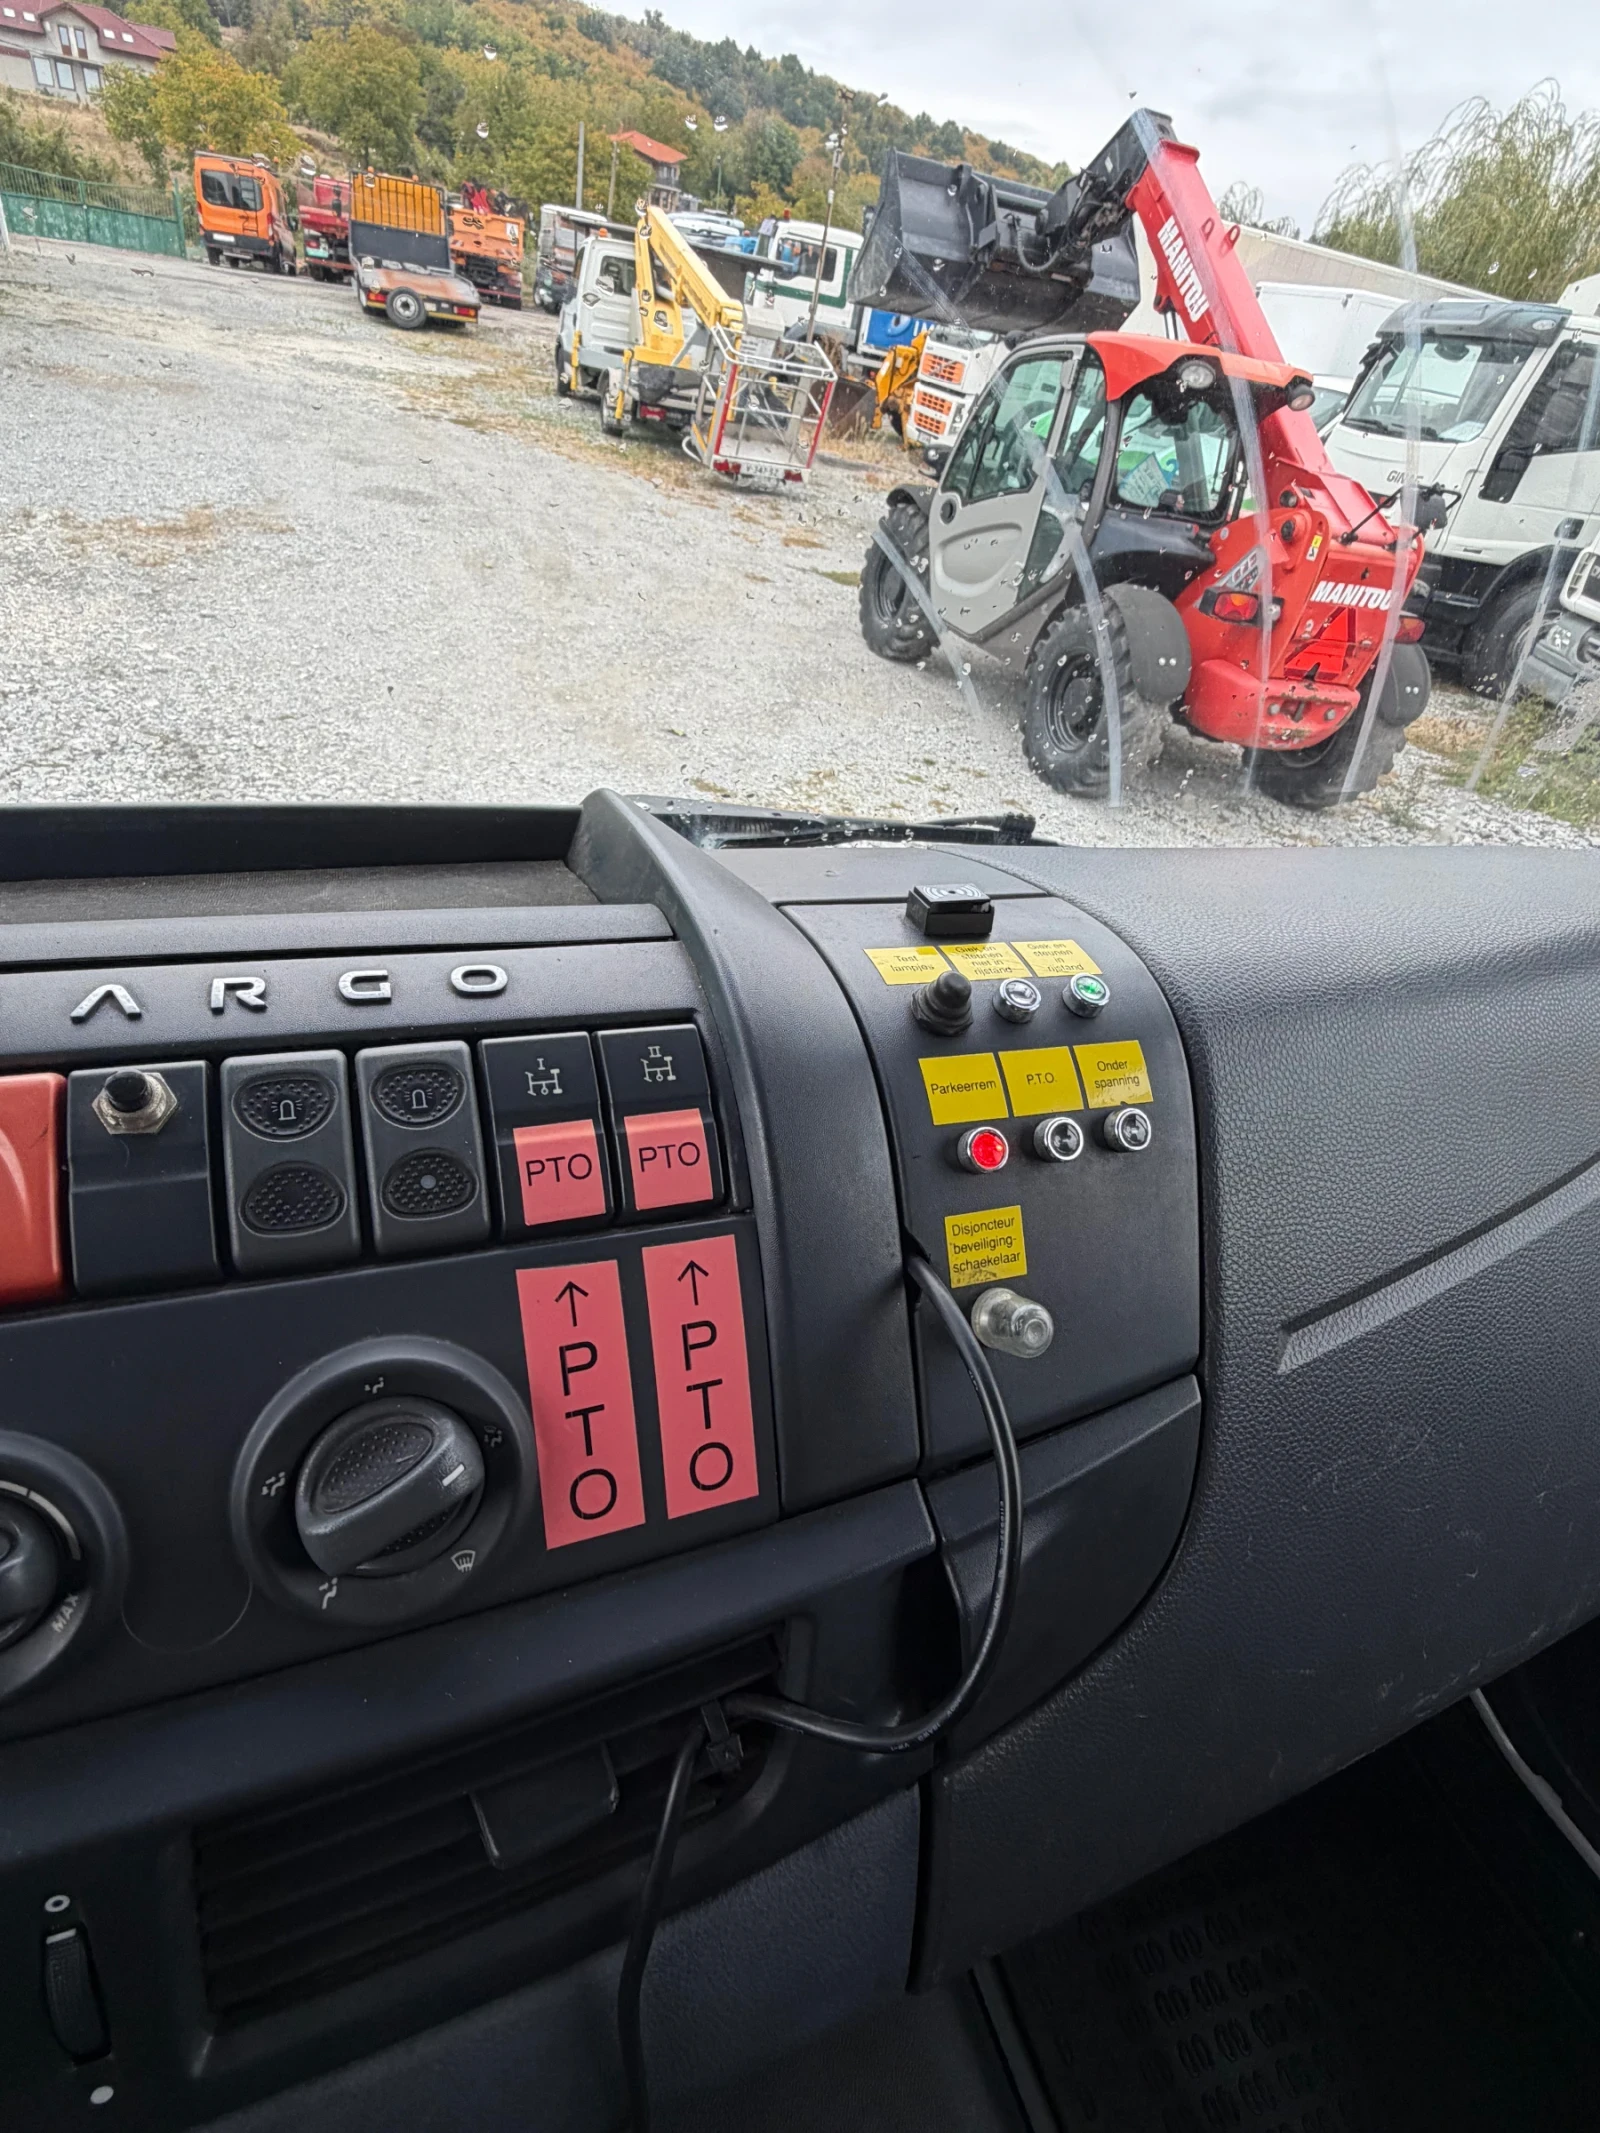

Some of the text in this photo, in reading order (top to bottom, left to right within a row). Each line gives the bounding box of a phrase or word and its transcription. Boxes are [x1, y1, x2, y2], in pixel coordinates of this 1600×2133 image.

[1157, 214, 1209, 322] MANITOU
[1310, 581, 1400, 611] MANITOU
[890, 964, 935, 972] lampjes
[1097, 1060, 1128, 1072] Onder
[930, 1079, 997, 1095] Parkeerrem
[1026, 1072, 1057, 1086] P.T.O.
[1094, 1074, 1140, 1089] spanning
[638, 1142, 700, 1173] PTO
[525, 1153, 592, 1187] PTO
[951, 1217, 1015, 1237] Disjoncteur
[952, 1235, 1017, 1255] beveiliging-
[953, 1252, 1021, 1273] schaekelaar
[681, 1320, 734, 1491] PTO
[558, 1340, 618, 1520] PTO
[51, 1593, 79, 1633] MAX
